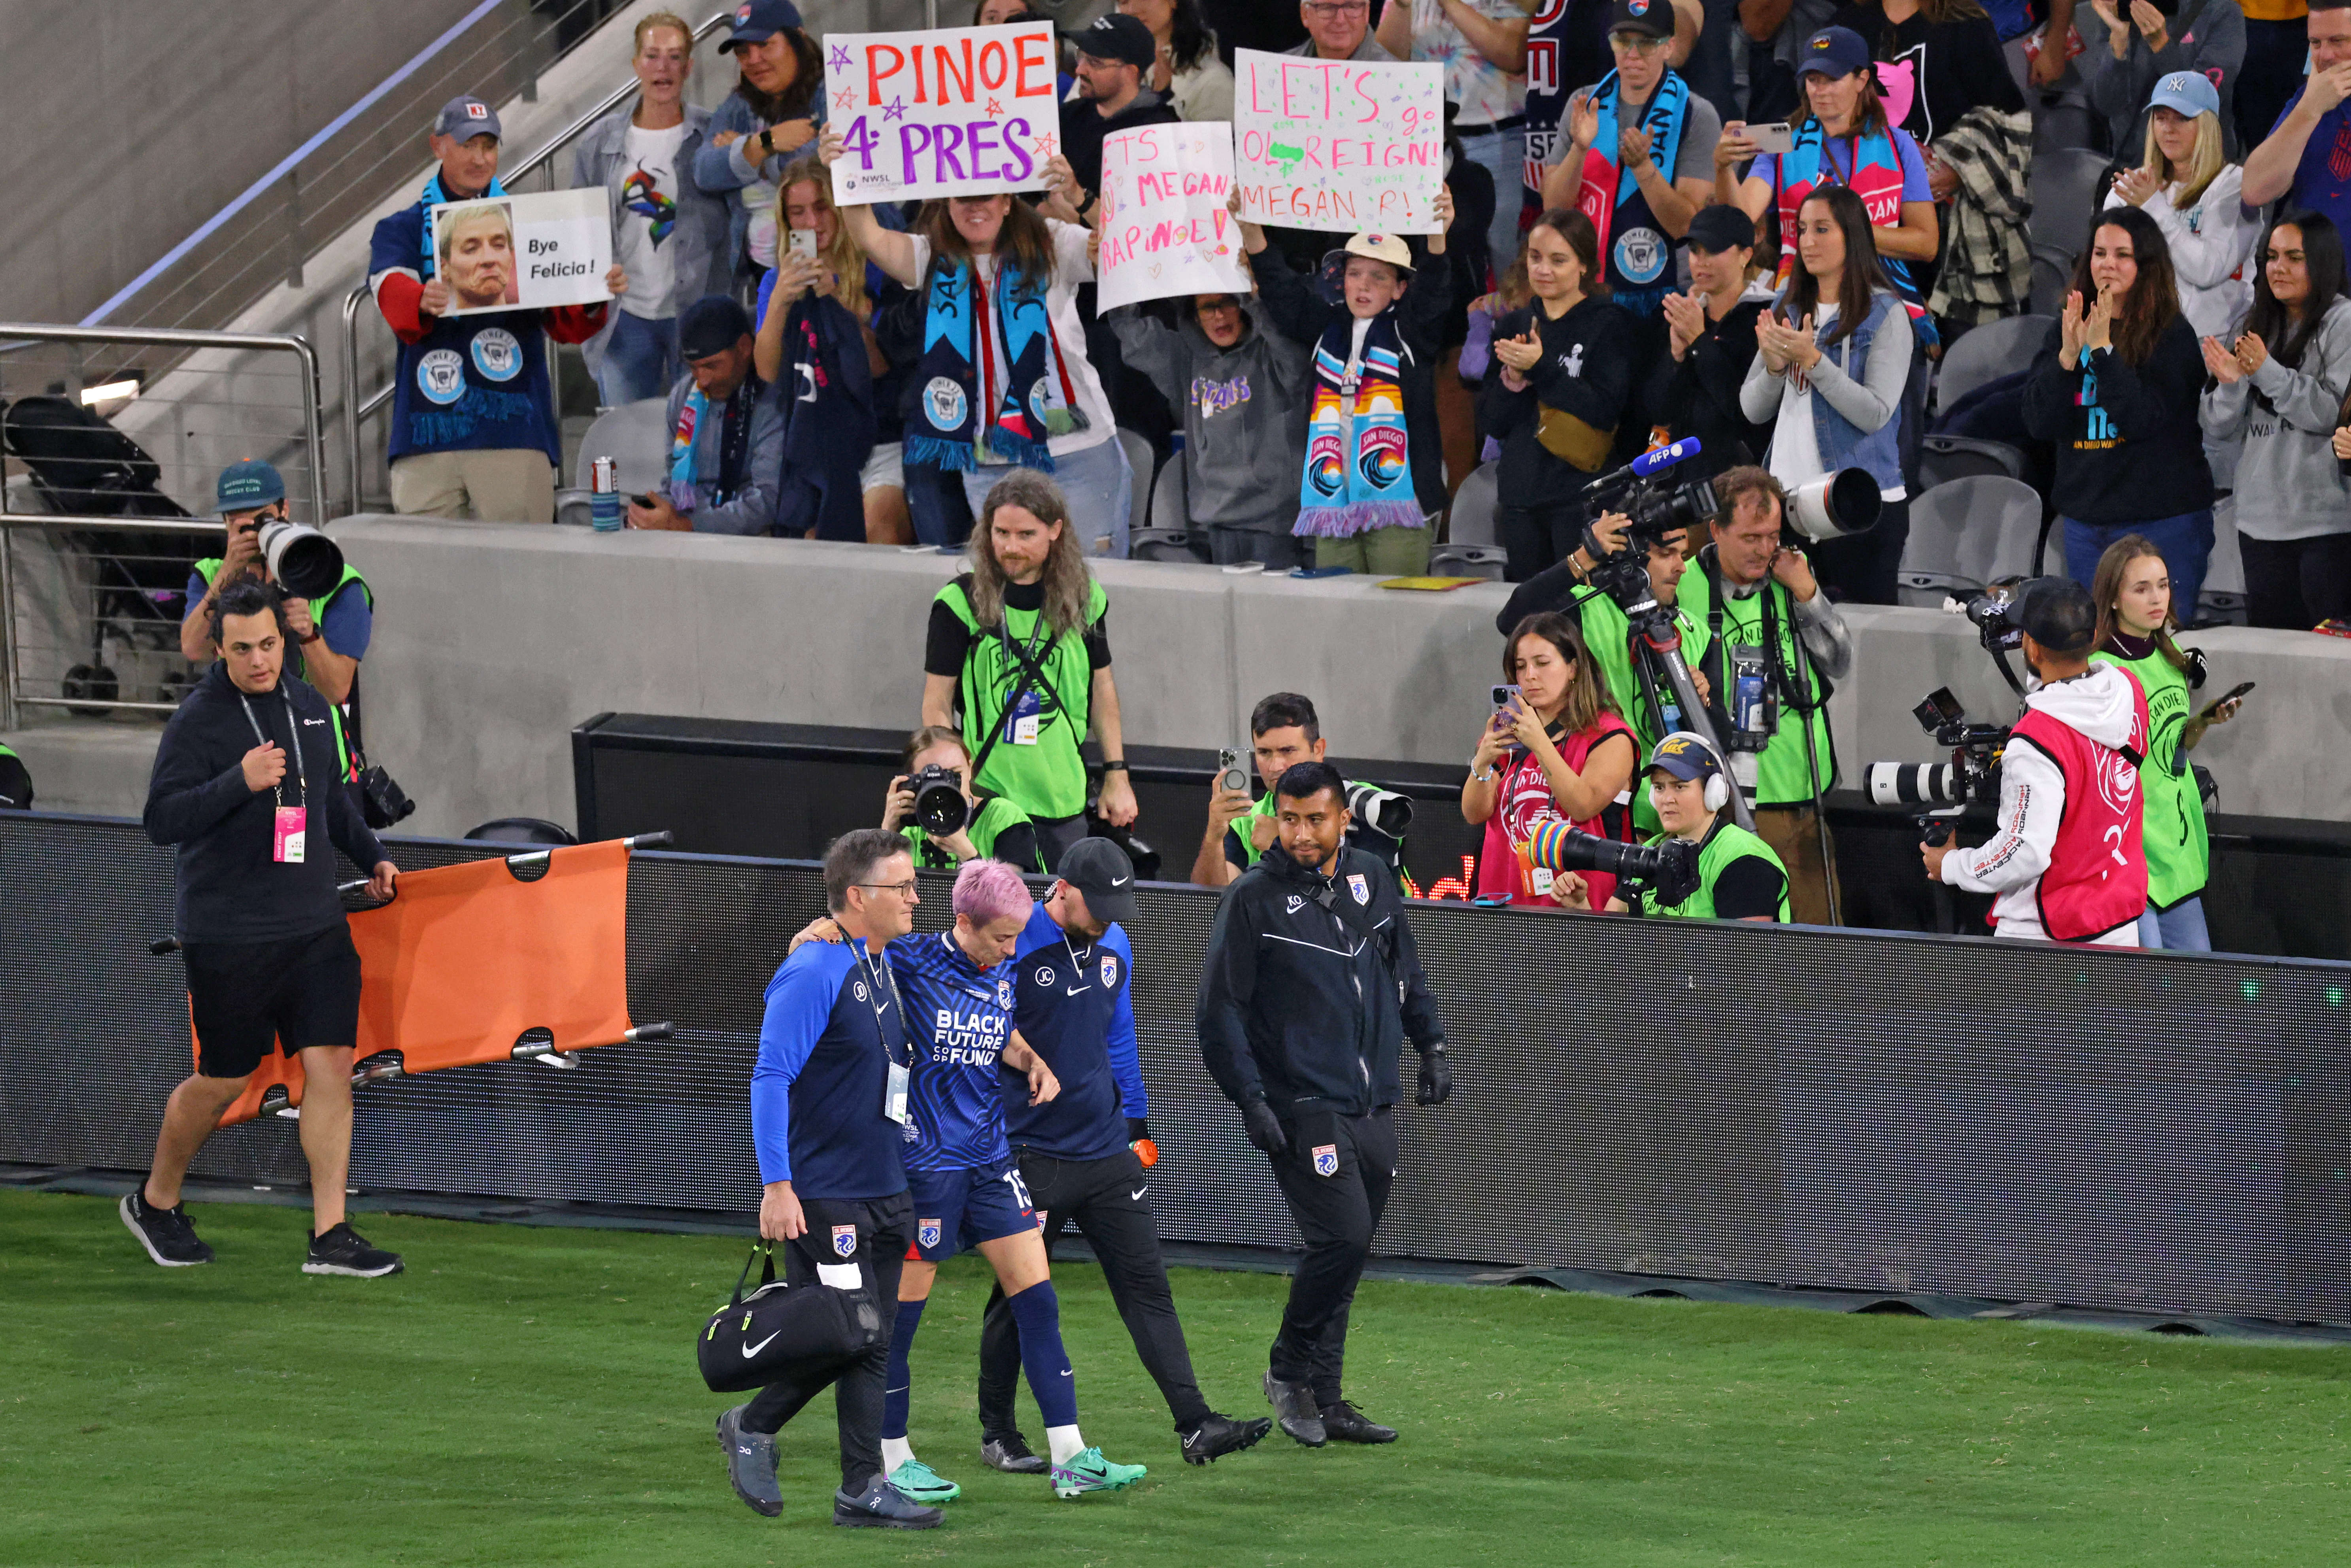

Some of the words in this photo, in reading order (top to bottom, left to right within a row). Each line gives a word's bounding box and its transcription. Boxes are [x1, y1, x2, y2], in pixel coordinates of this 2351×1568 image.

[865, 33, 1052, 106] PINOE
[2167, 76, 2186, 92] NY
[1251, 62, 1379, 123] LET'S
[1402, 106, 1435, 136] go
[900, 118, 1034, 185] PRES
[1304, 135, 1438, 171] REIGN!
[1138, 171, 1228, 206] MEGAN
[1242, 185, 1356, 219] MEGAN
[1380, 190, 1413, 217] R!
[529, 239, 558, 256] Bye
[531, 261, 586, 279] Felicia
[1325, 440, 1340, 452] DIEG
[1363, 431, 1377, 448] SAN
[1378, 430, 1403, 445] DIEGO
[1649, 449, 1669, 465] AFP
[1670, 652, 1686, 681] sachtler
[2149, 700, 2165, 726] SAN
[1659, 738, 1691, 756] Cal
[1287, 895, 1302, 907] KO
[850, 943, 858, 954] NWSL
[1039, 971, 1052, 982] JC
[857, 985, 865, 998] JD
[937, 1009, 1006, 1035] BLACK
[935, 1029, 1004, 1050] FUTURE
[933, 1054, 948, 1062] OP
[934, 1046, 949, 1054] CO
[949, 1048, 996, 1066] FUND
[1003, 1169, 1033, 1209] 15
